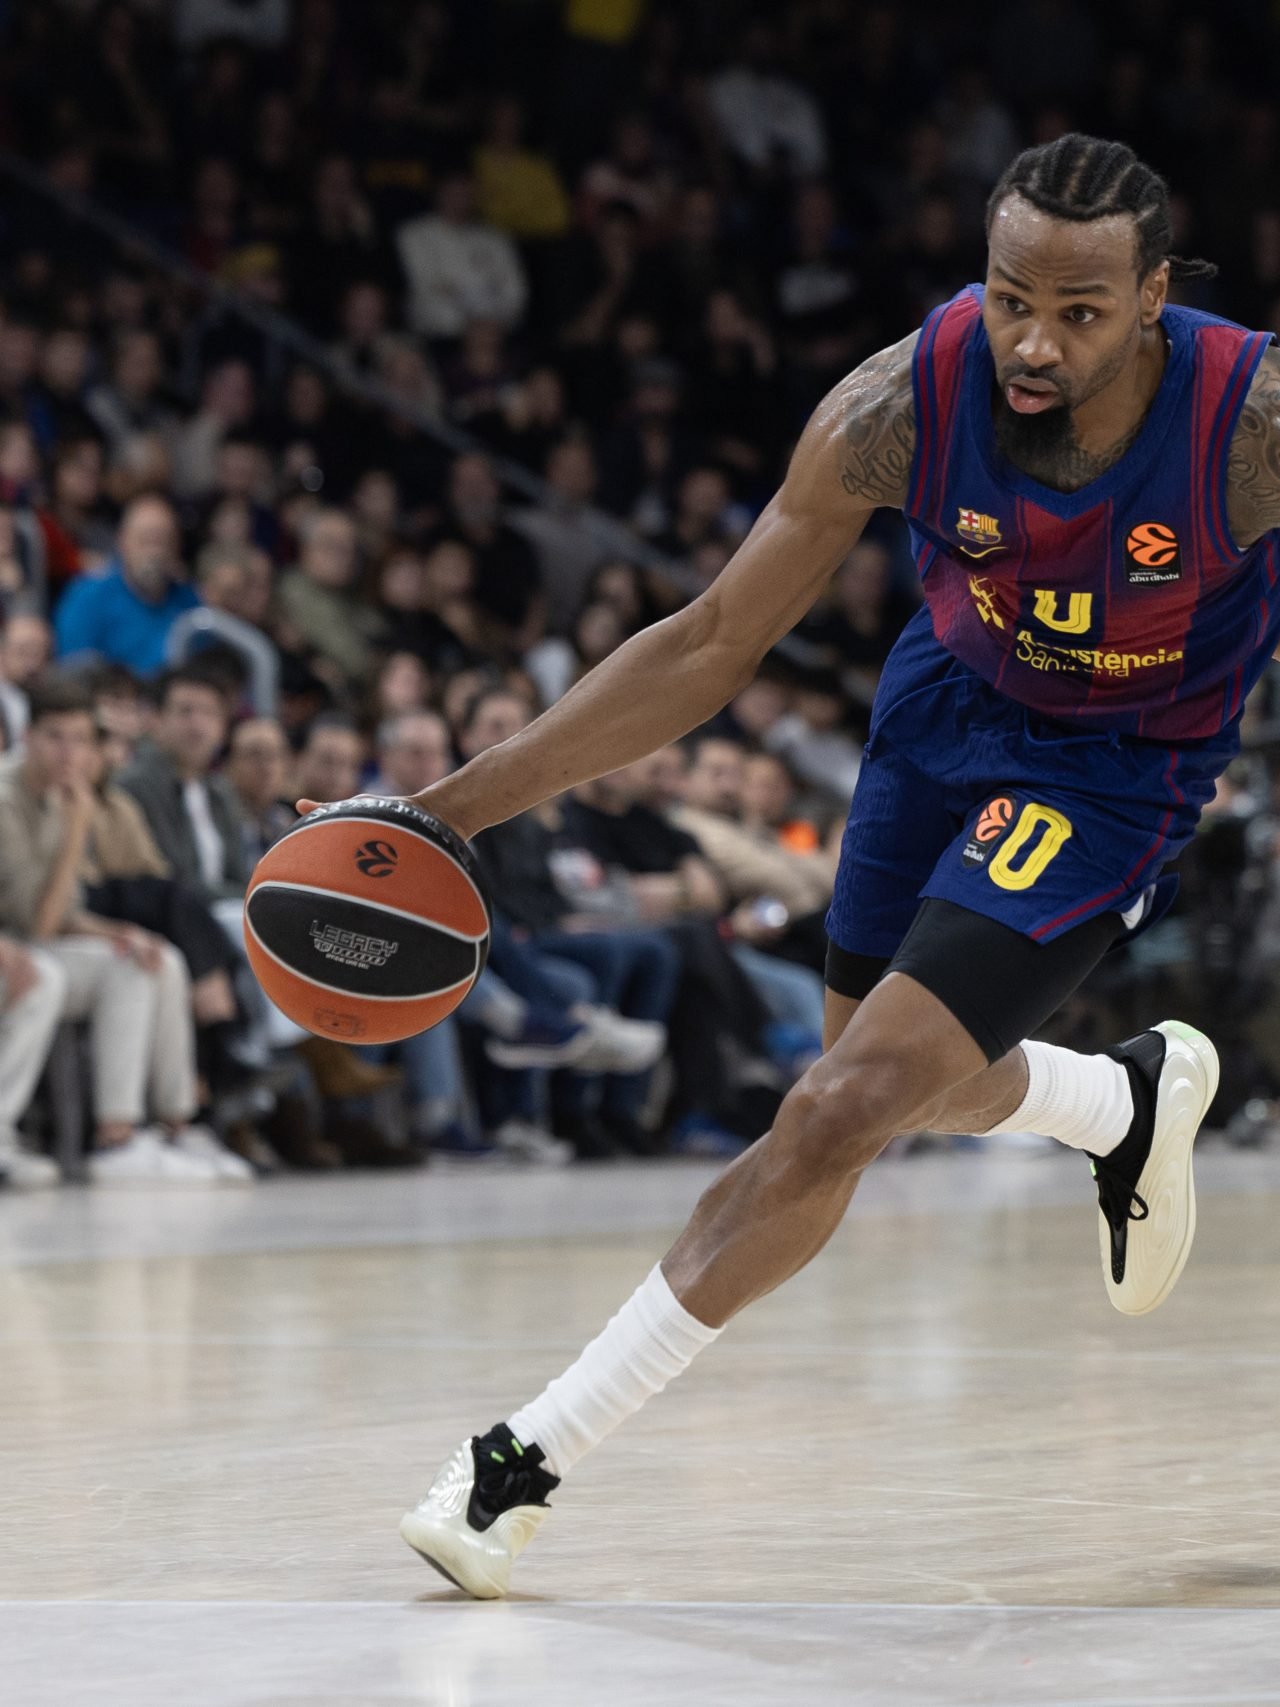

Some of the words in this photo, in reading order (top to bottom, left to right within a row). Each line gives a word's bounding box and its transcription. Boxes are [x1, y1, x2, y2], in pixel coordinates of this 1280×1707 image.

[1129, 574, 1148, 583] abu
[1150, 573, 1179, 581] dhabi
[988, 802, 1073, 891] 0
[308, 919, 399, 958] LEGACY
